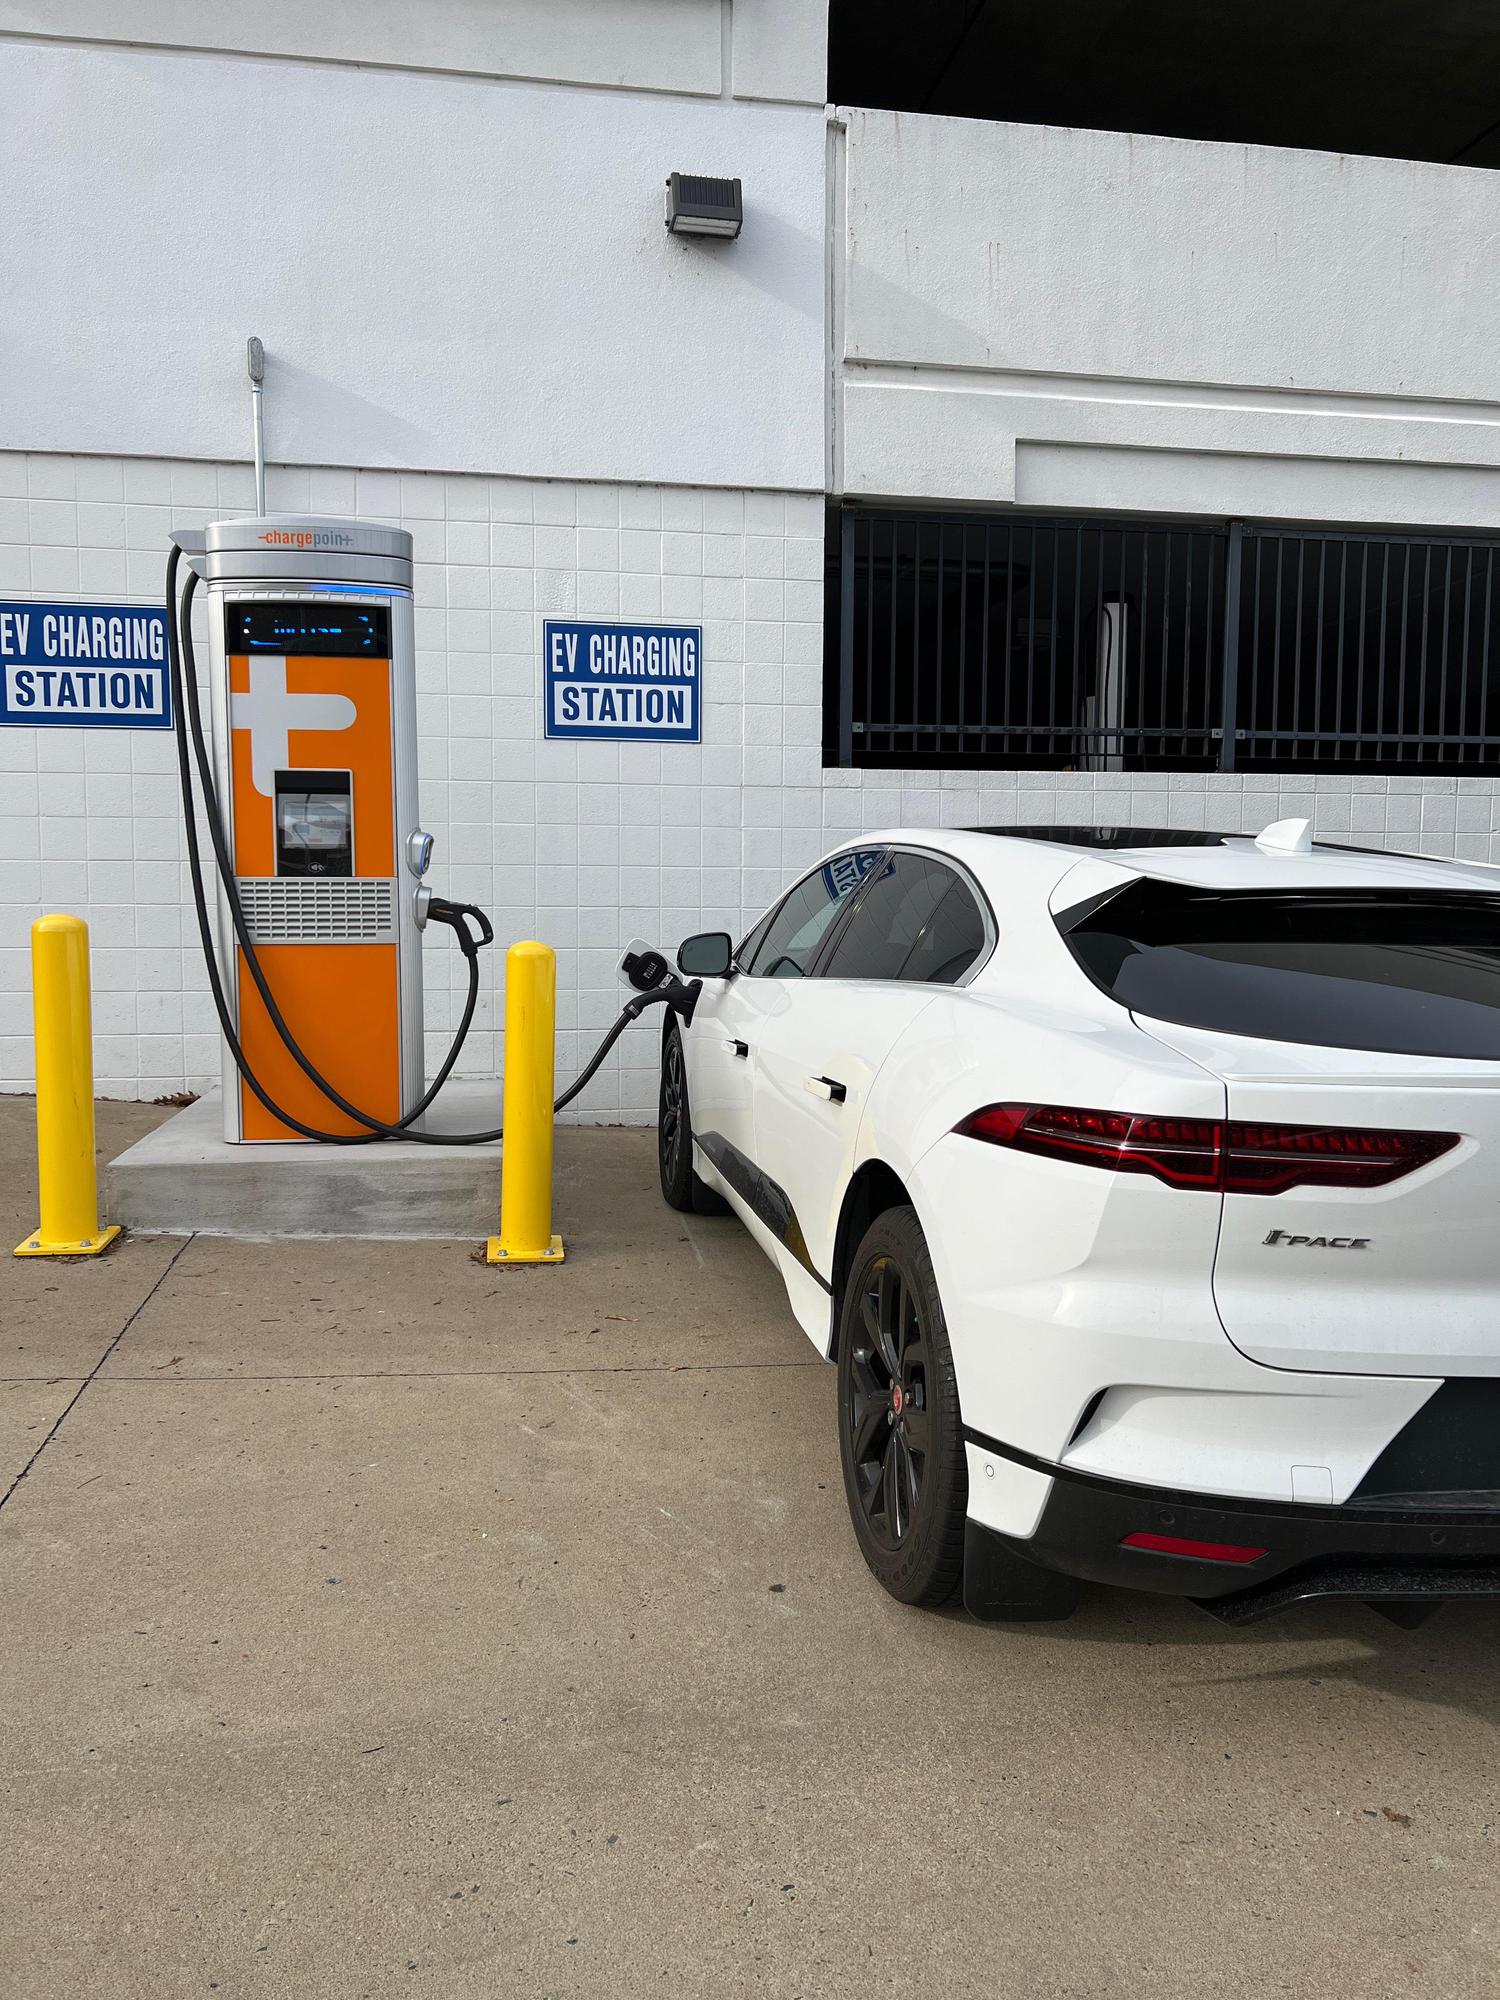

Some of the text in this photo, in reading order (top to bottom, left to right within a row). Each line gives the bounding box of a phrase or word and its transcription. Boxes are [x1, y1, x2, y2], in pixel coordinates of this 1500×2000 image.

[0, 613, 164, 661] EV CHARGING
[551, 632, 696, 677] EV CHARGING
[15, 670, 154, 709] STATION
[562, 686, 684, 723] STATION
